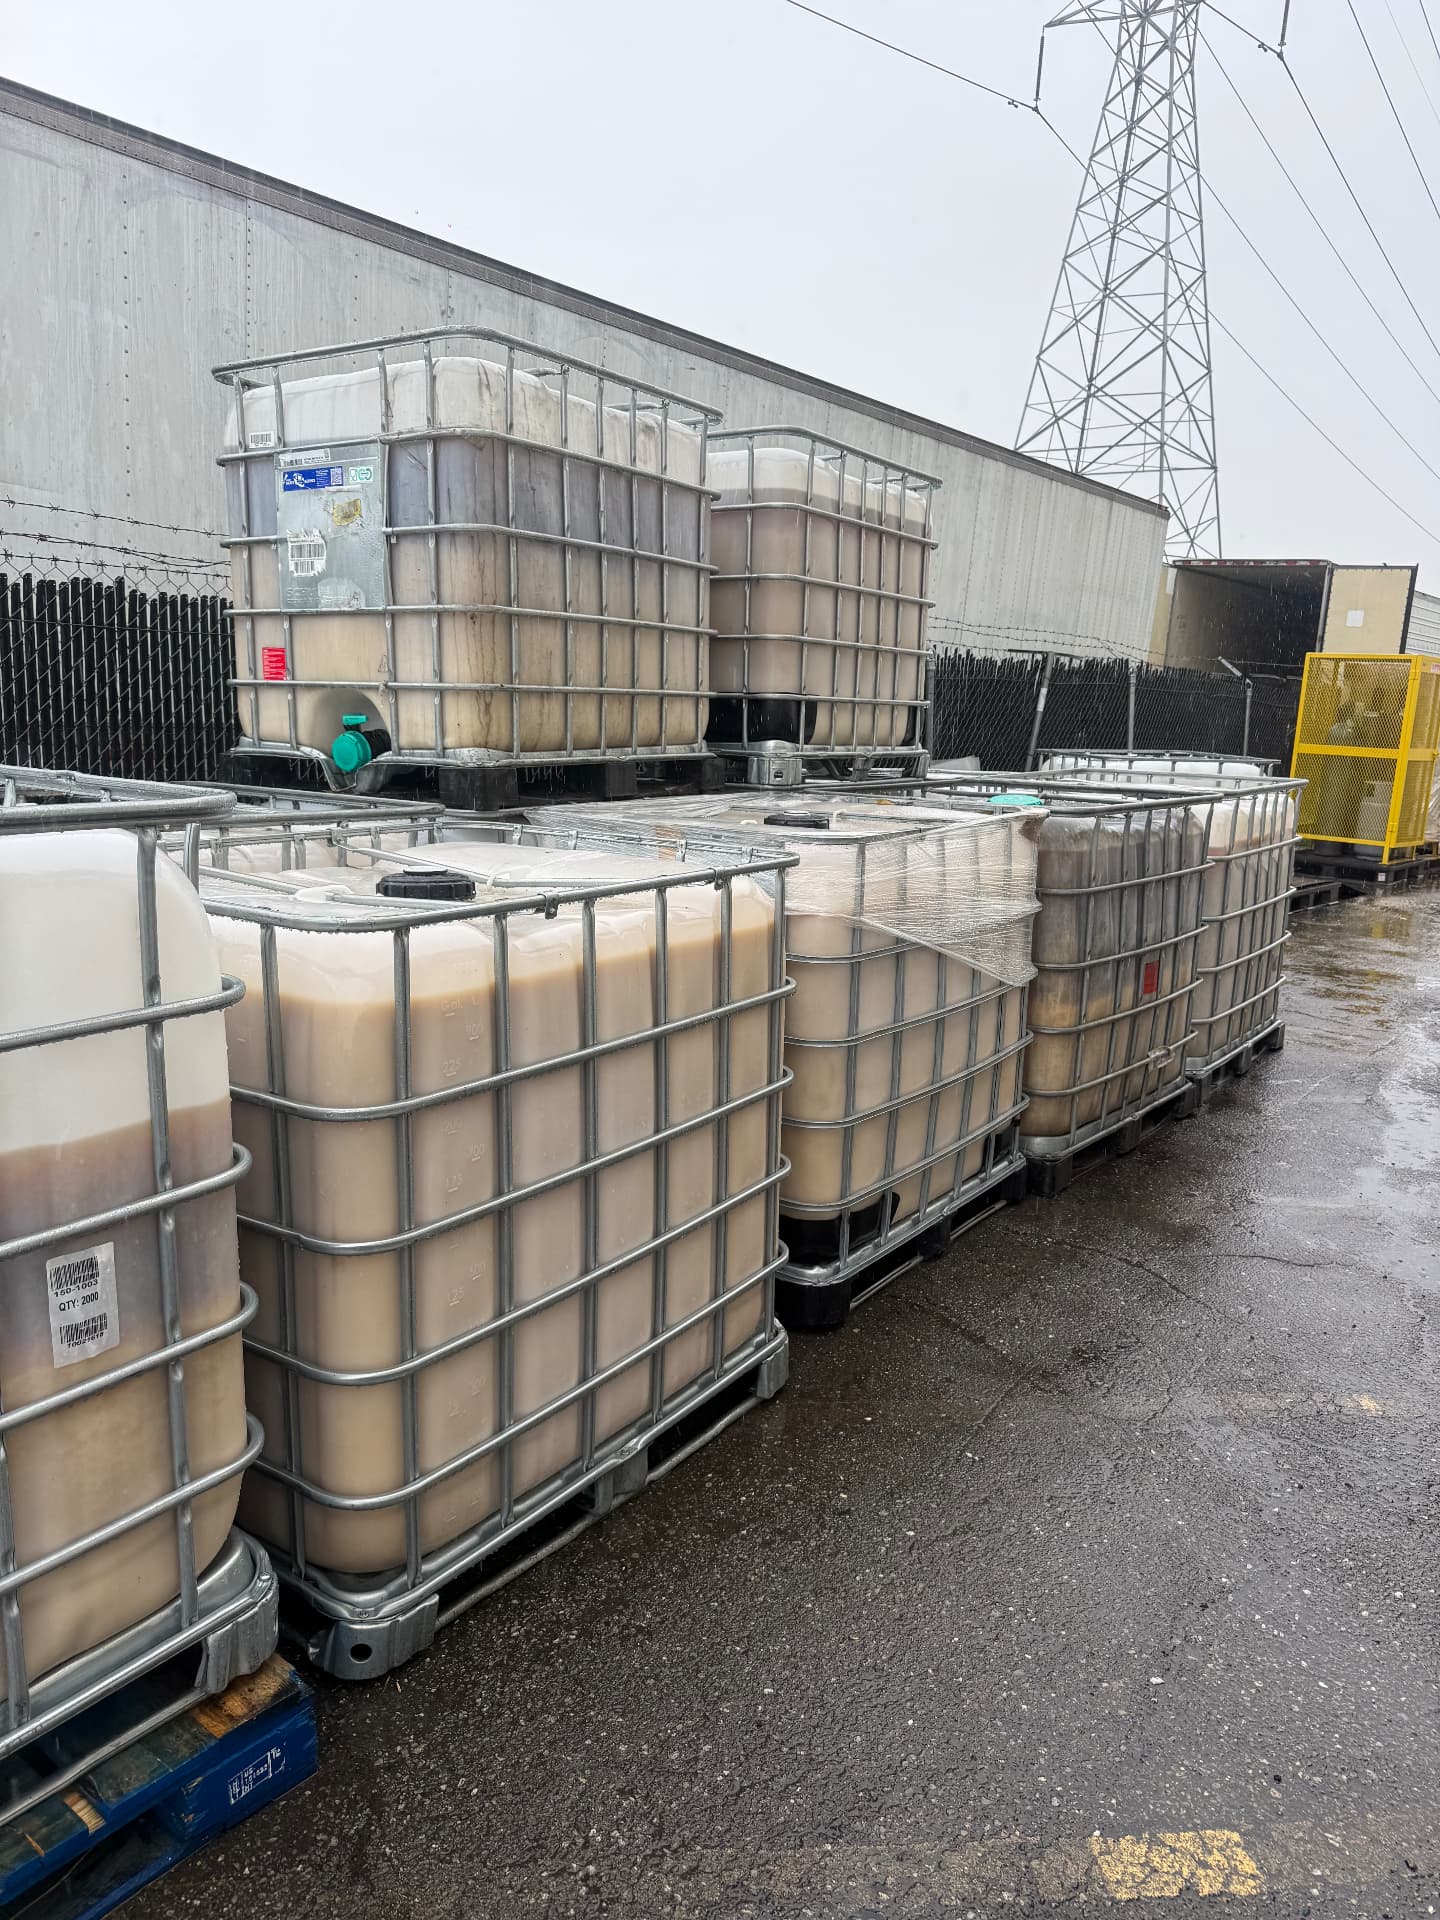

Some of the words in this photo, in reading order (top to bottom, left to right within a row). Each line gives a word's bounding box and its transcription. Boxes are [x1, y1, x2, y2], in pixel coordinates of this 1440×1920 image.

[54, 1278, 98, 1297] 150-1003
[59, 1299, 80, 1311] QTY:
[81, 1291, 99, 1305] 2000
